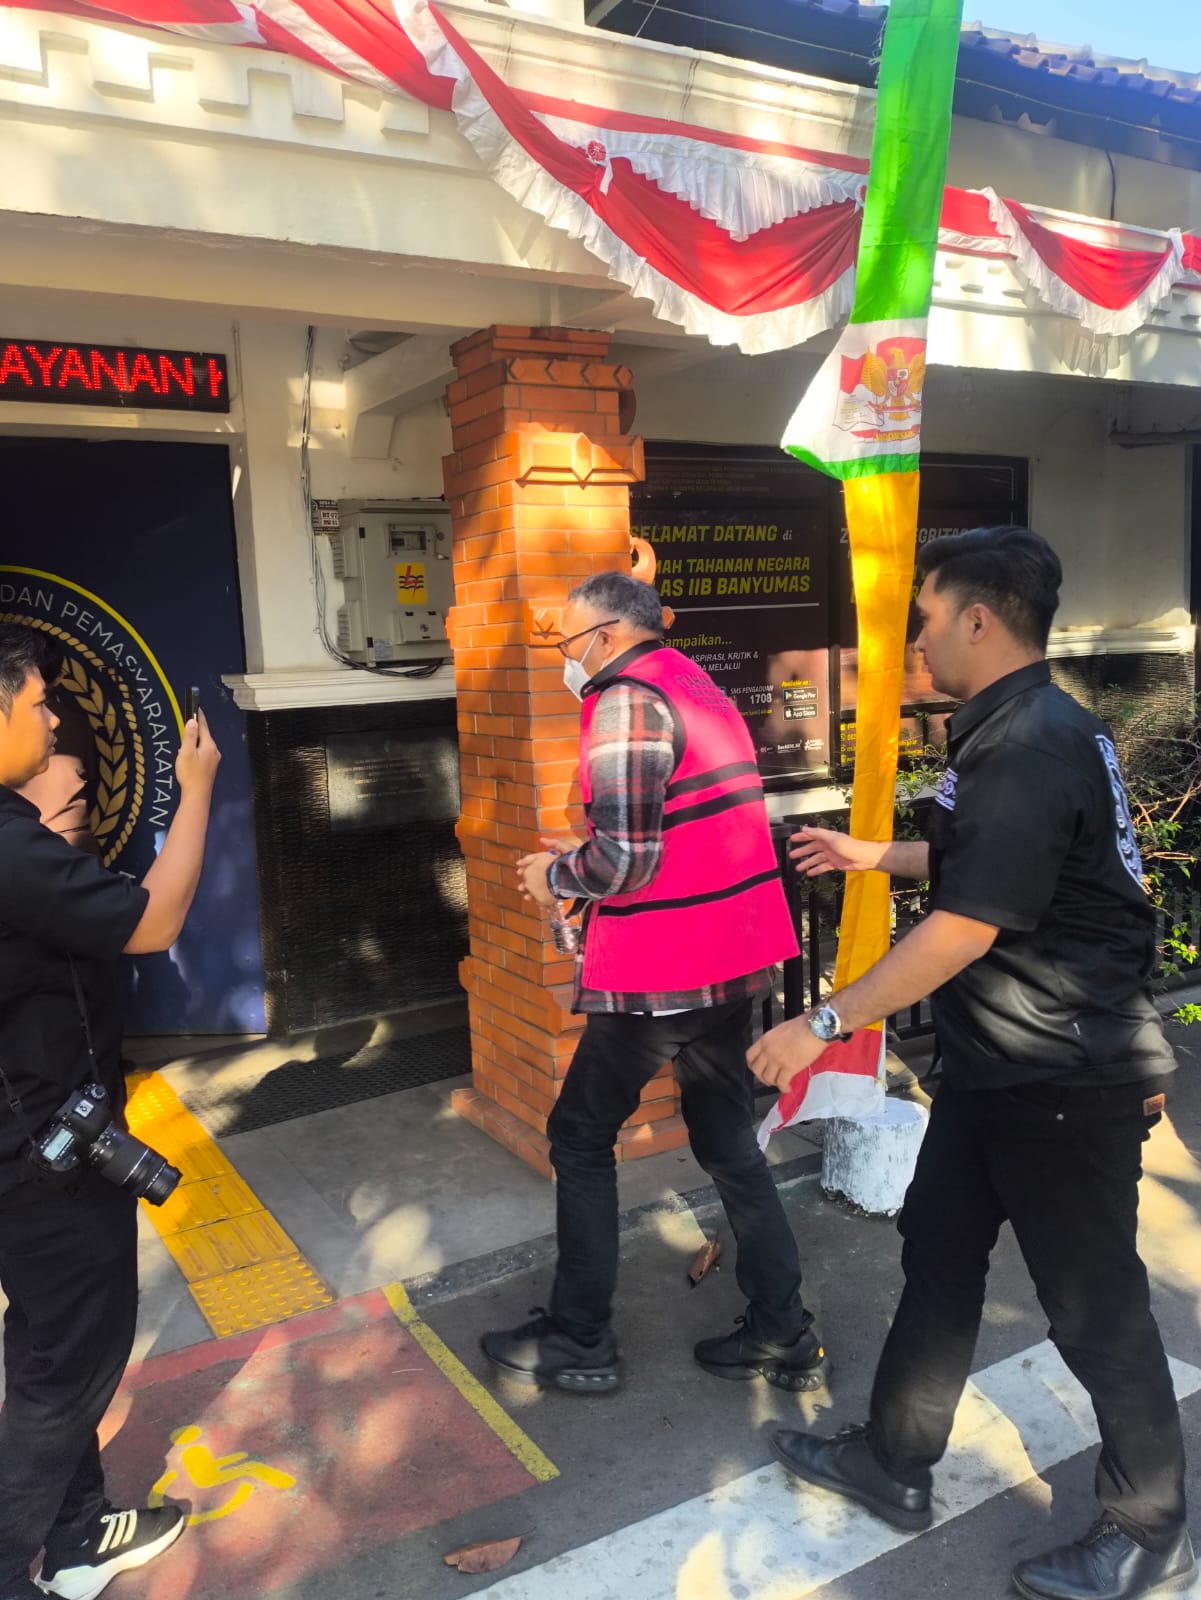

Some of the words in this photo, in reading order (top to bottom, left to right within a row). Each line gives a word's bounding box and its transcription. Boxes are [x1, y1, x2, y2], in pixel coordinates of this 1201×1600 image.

[0, 344, 193, 396] AYANAN
[629, 525, 711, 543] SELAMAT
[713, 525, 778, 542] DATANG
[782, 530, 792, 541] di
[686, 557, 754, 574] TAHANAN
[756, 556, 810, 572] NEGARA
[688, 578, 712, 596] IIB
[716, 576, 811, 595] BANYUMAS
[0, 584, 54, 611] DAN
[728, 651, 752, 661] KRITIK
[753, 651, 759, 660] &
[708, 662, 741, 671] MELALUI
[730, 687, 742, 695] SMS
[742, 685, 774, 694] PENGADUAN
[750, 693, 773, 704] 1708
[60, 600, 173, 827] PEMASYARAKATAN
